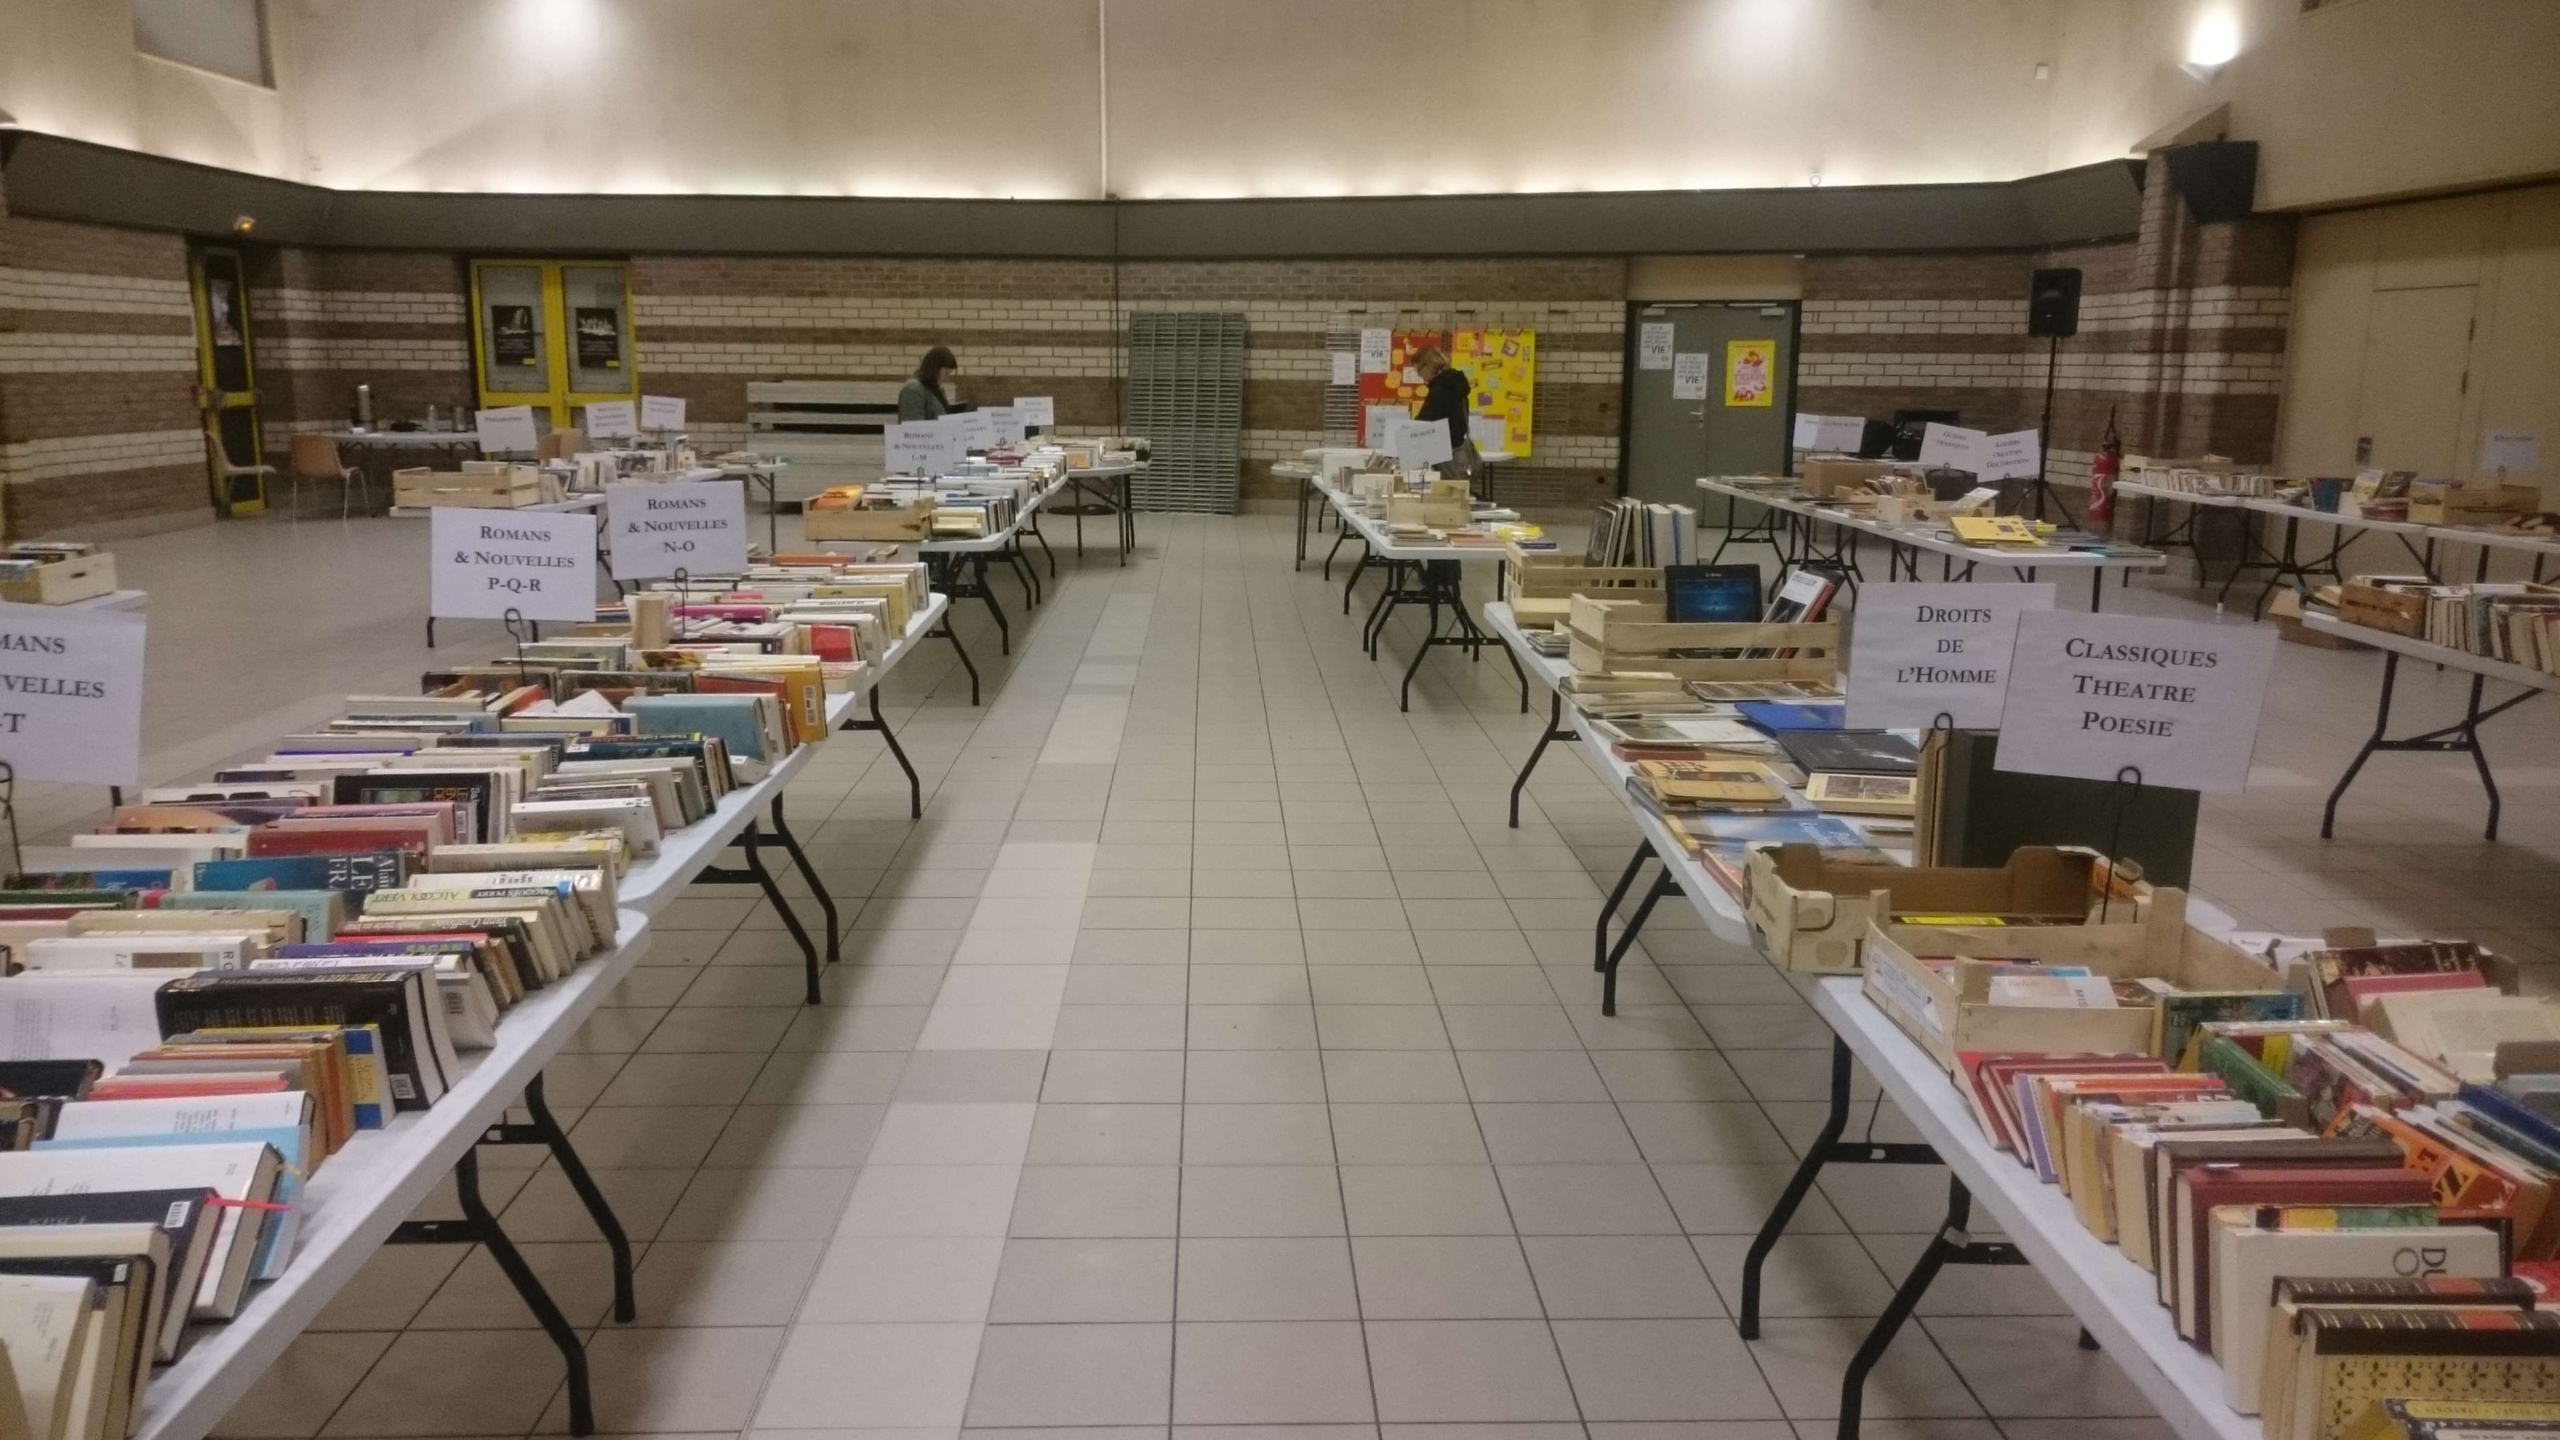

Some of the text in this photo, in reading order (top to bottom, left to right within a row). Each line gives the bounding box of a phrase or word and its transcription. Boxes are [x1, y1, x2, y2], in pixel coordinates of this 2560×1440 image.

[648, 498, 707, 511] ROMANS
[480, 524, 551, 543] ROMANS
[628, 519, 728, 533] & NOUVELLES
[663, 540, 695, 553] N-O
[455, 550, 575, 569] & NOUVELLES
[488, 576, 542, 595] P-Q-R
[1916, 605, 1992, 624] DROITS
[1937, 639, 1964, 654] DE
[2065, 637, 2218, 669] CLASSIQUES
[1897, 666, 1996, 685] L'HOMME
[2073, 674, 2197, 704] THEATRE
[2081, 711, 2174, 738] POESIE
[371, 891, 460, 903] ALCOOL VERT
[476, 889, 507, 899] PERRY
[482, 916, 508, 929] Yann
